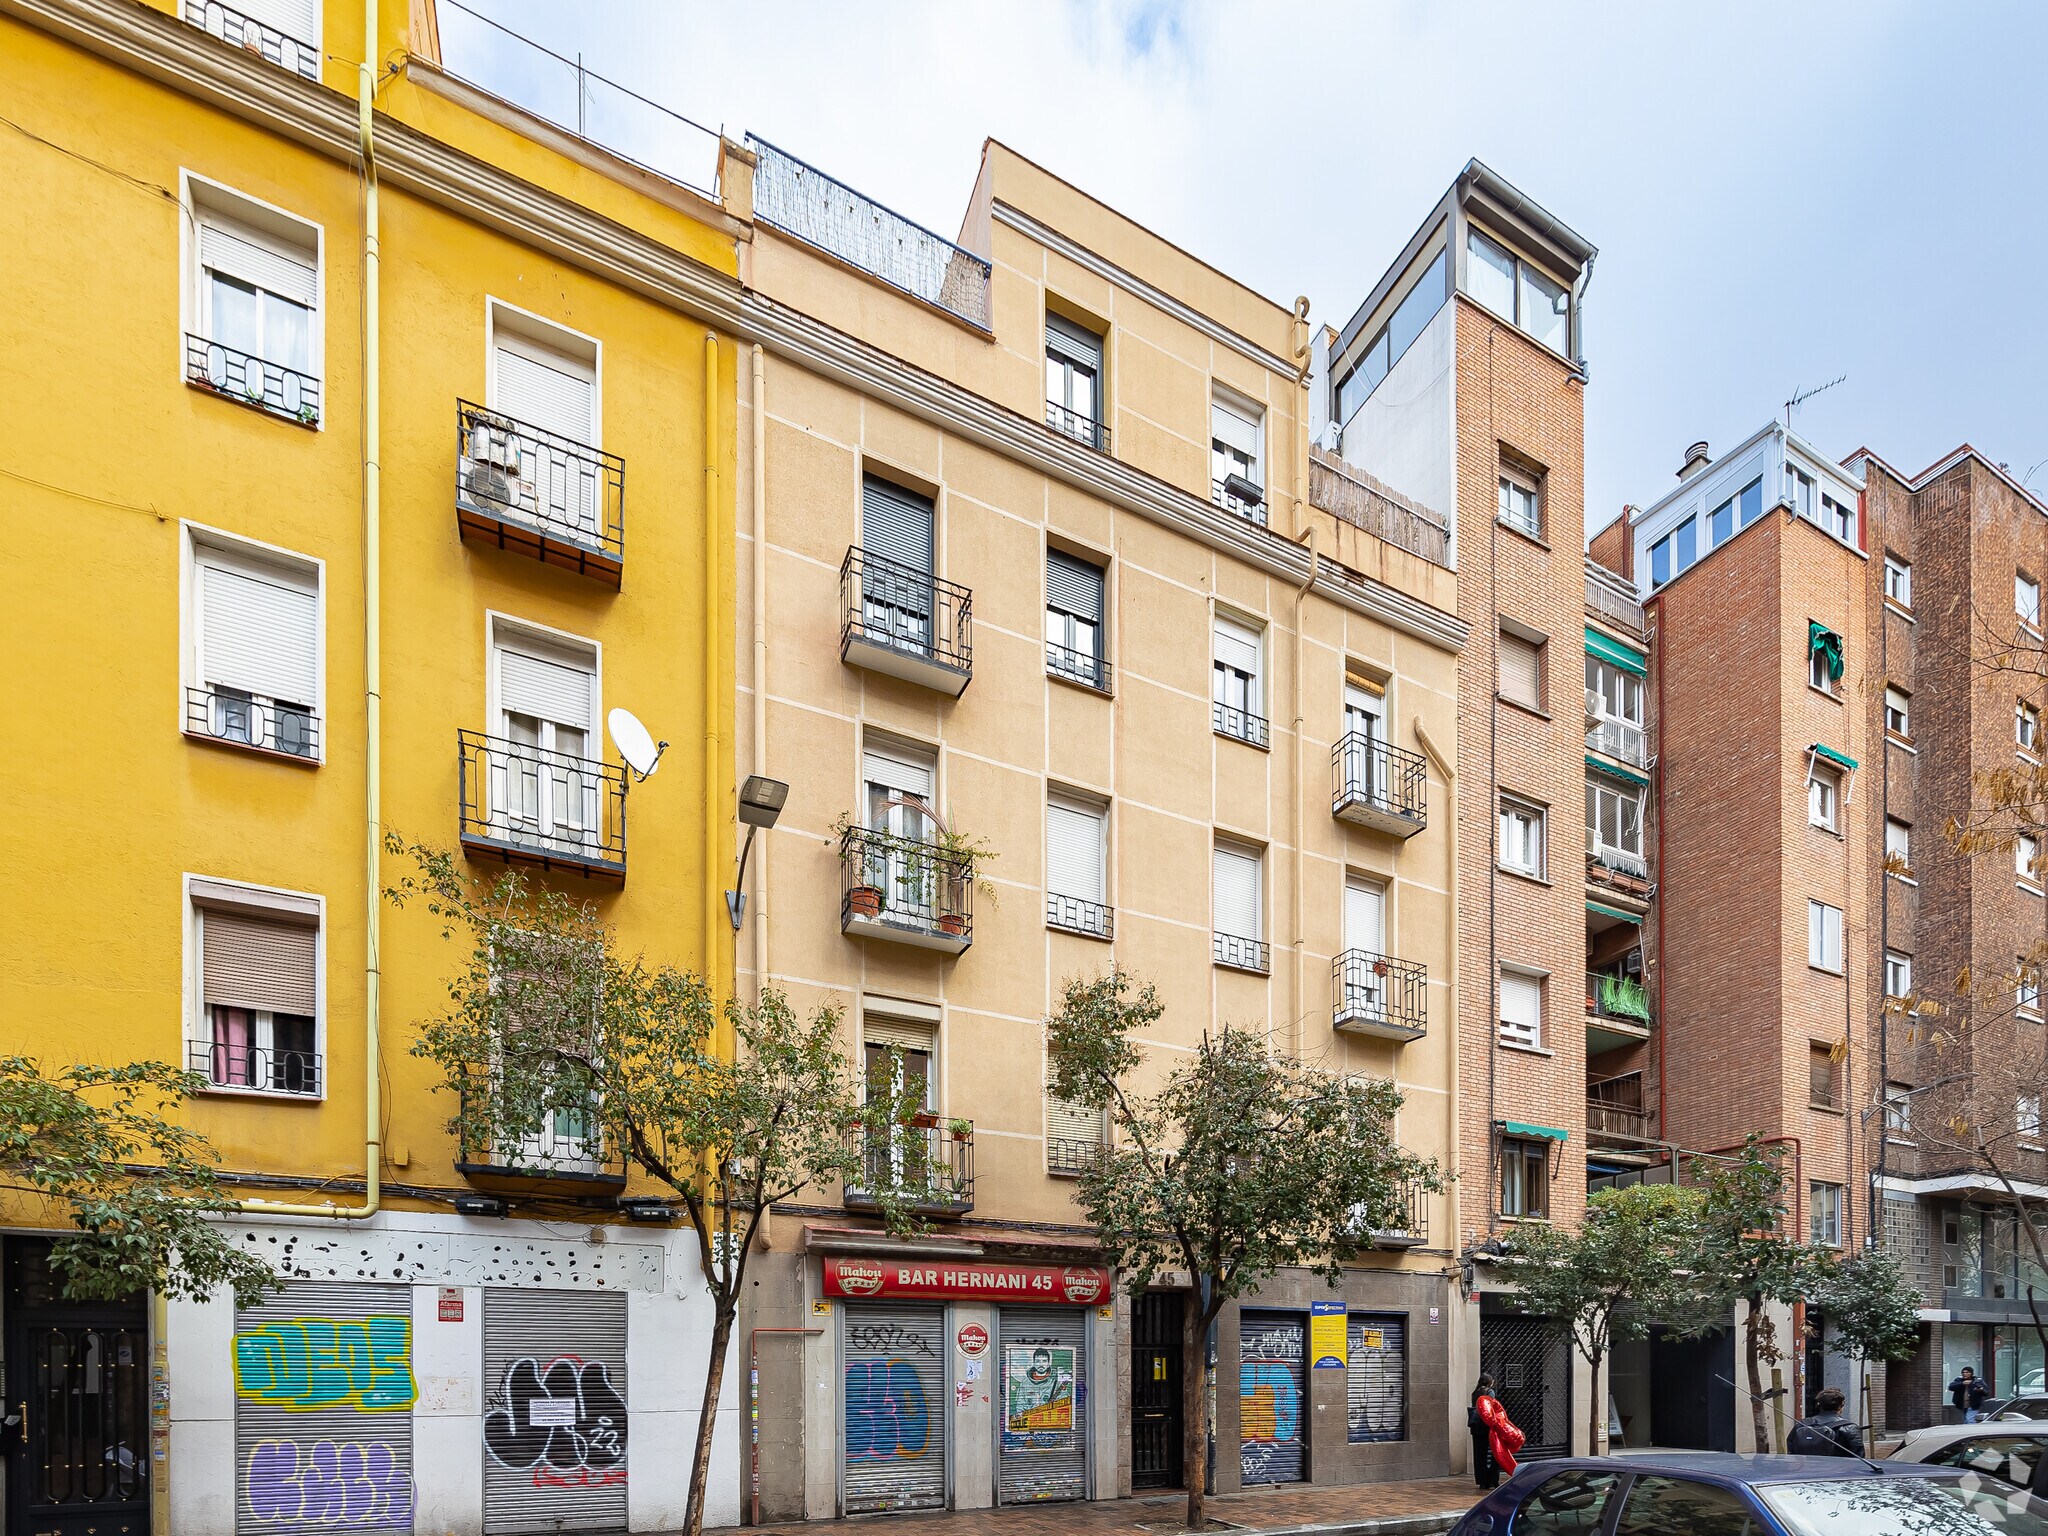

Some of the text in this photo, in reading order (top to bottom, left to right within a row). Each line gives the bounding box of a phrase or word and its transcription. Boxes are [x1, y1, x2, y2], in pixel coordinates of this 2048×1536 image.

[839, 1265, 882, 1280] Mahou
[897, 1268, 1053, 1291] BAR HERNANI 45
[1158, 1271, 1175, 1286] 45
[1065, 1275, 1100, 1288] Mahou
